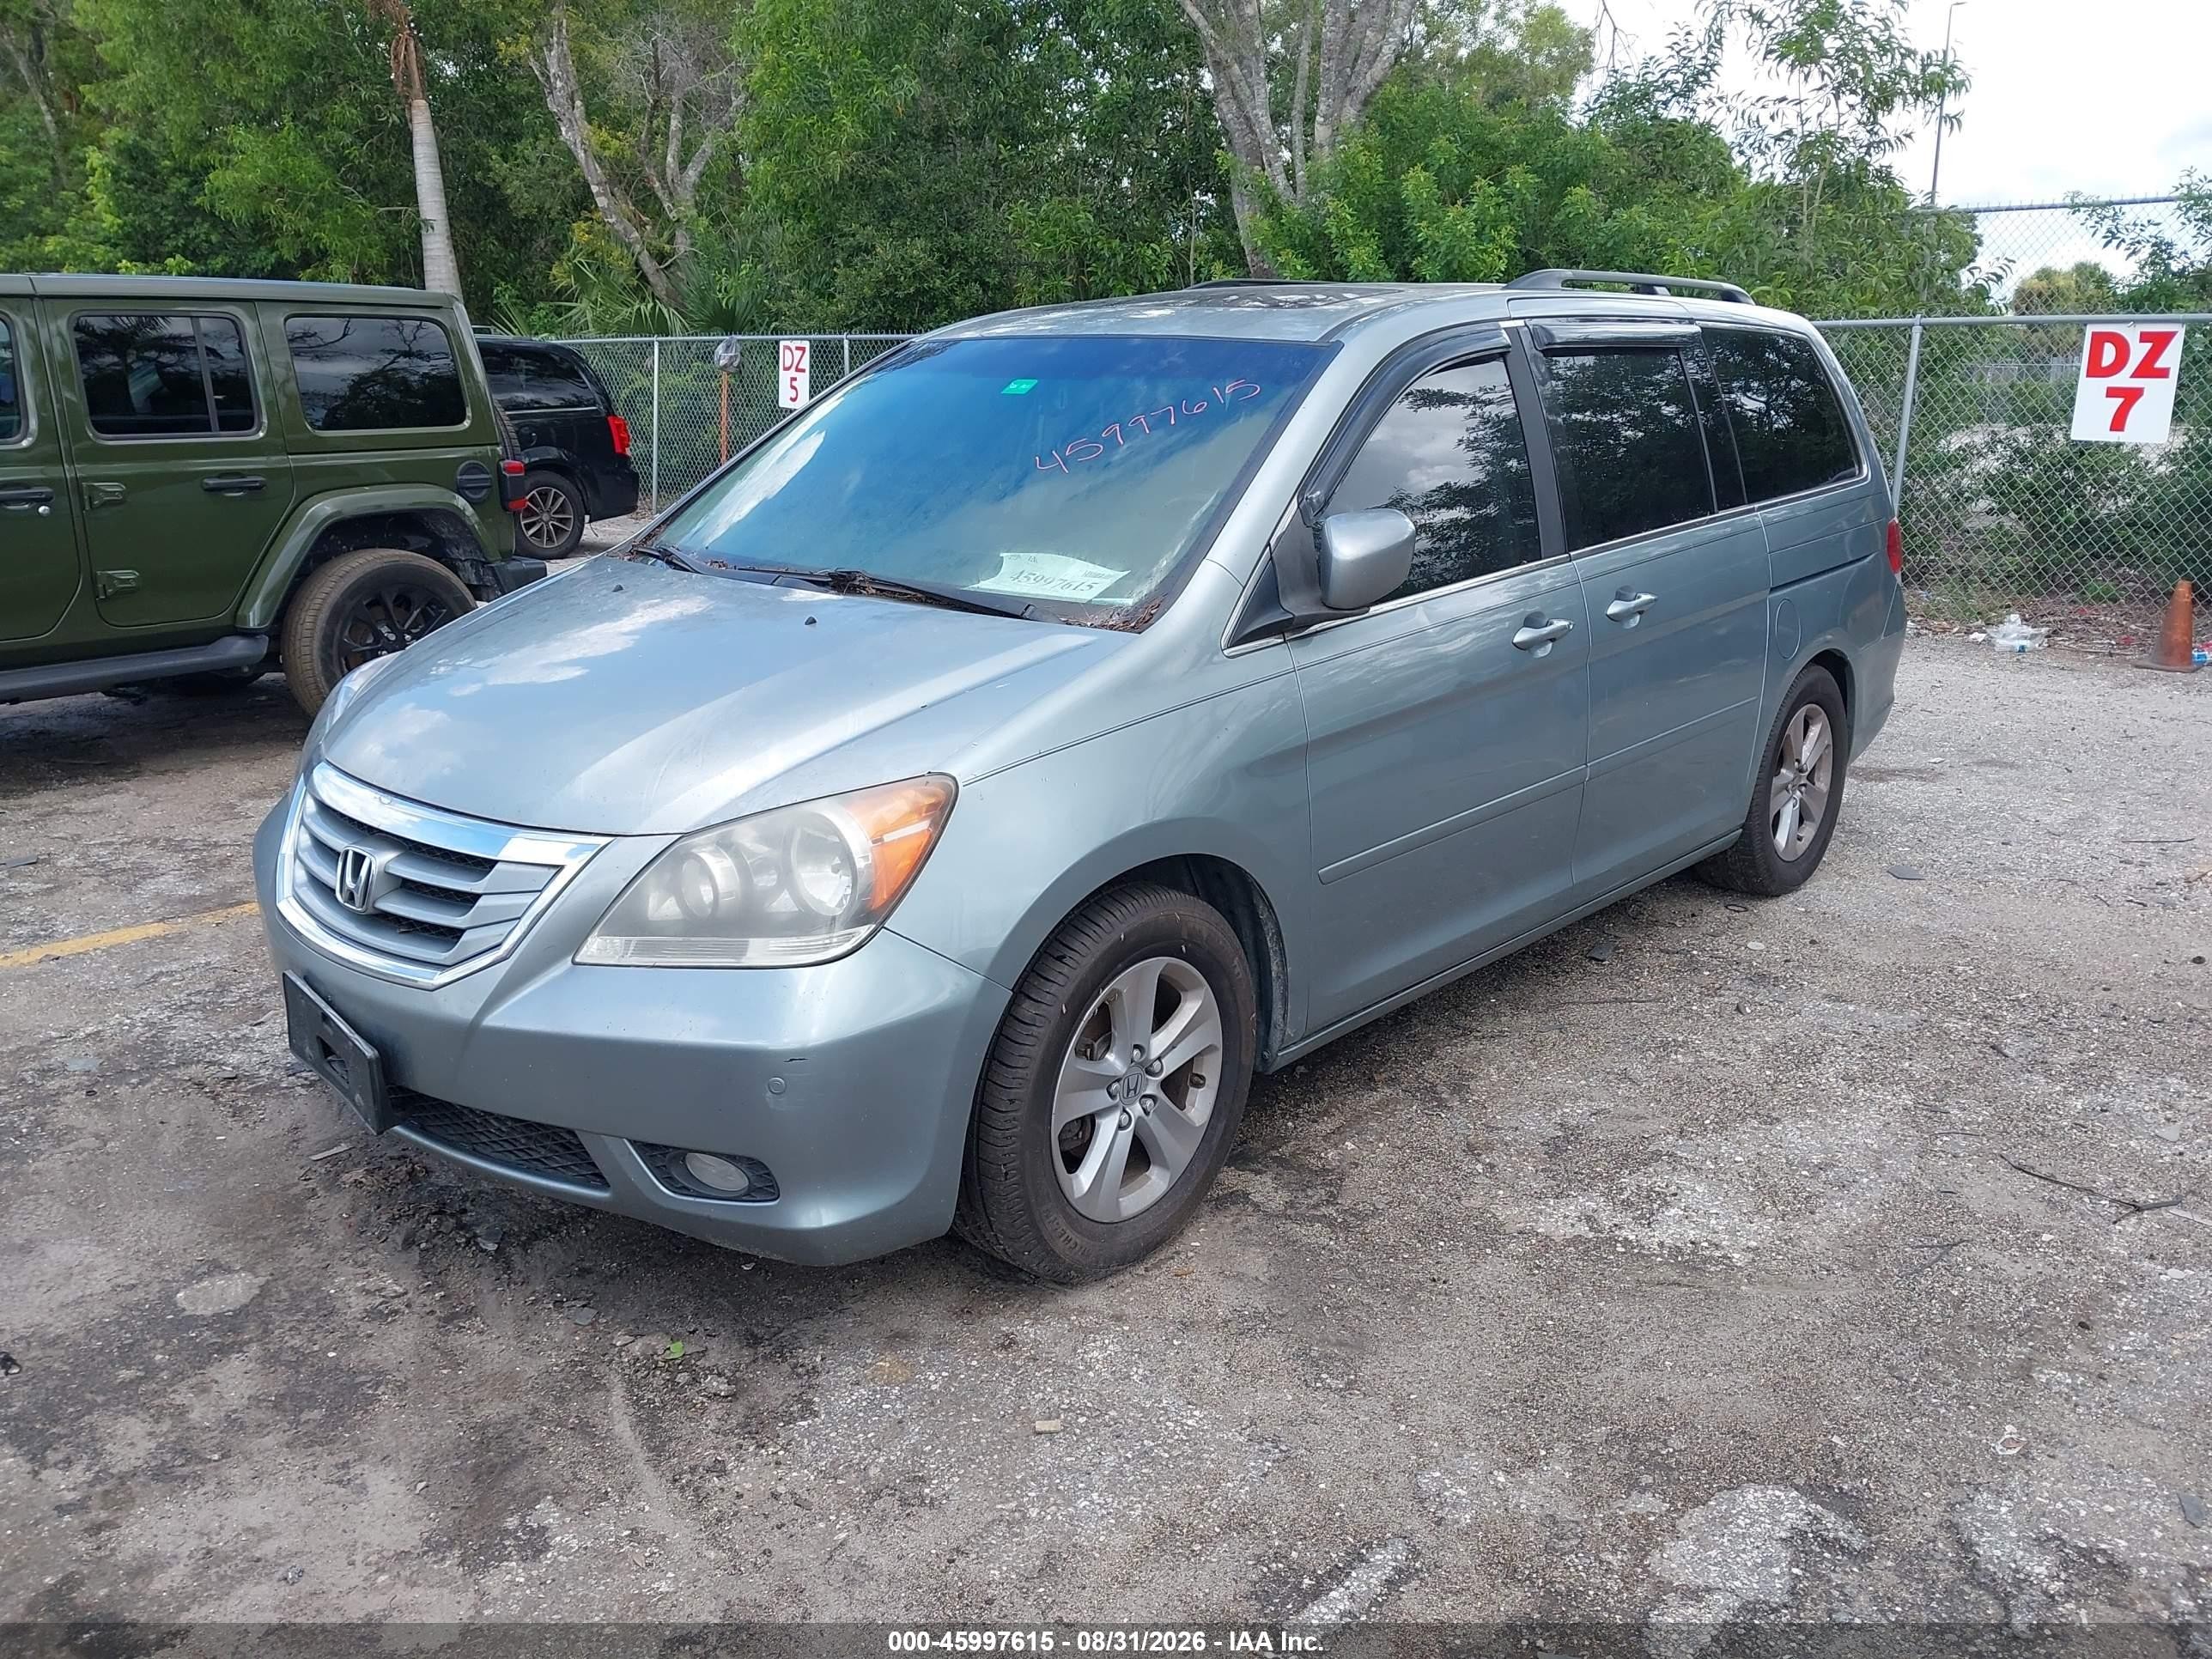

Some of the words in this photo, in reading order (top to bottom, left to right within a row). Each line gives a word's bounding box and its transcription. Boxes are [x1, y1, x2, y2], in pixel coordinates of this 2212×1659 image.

[782, 344, 806, 374] DZ
[2086, 331, 2179, 379] DZ
[789, 377, 799, 403] 5
[2106, 386, 2145, 432] 7
[1035, 378, 1261, 474] 45997615
